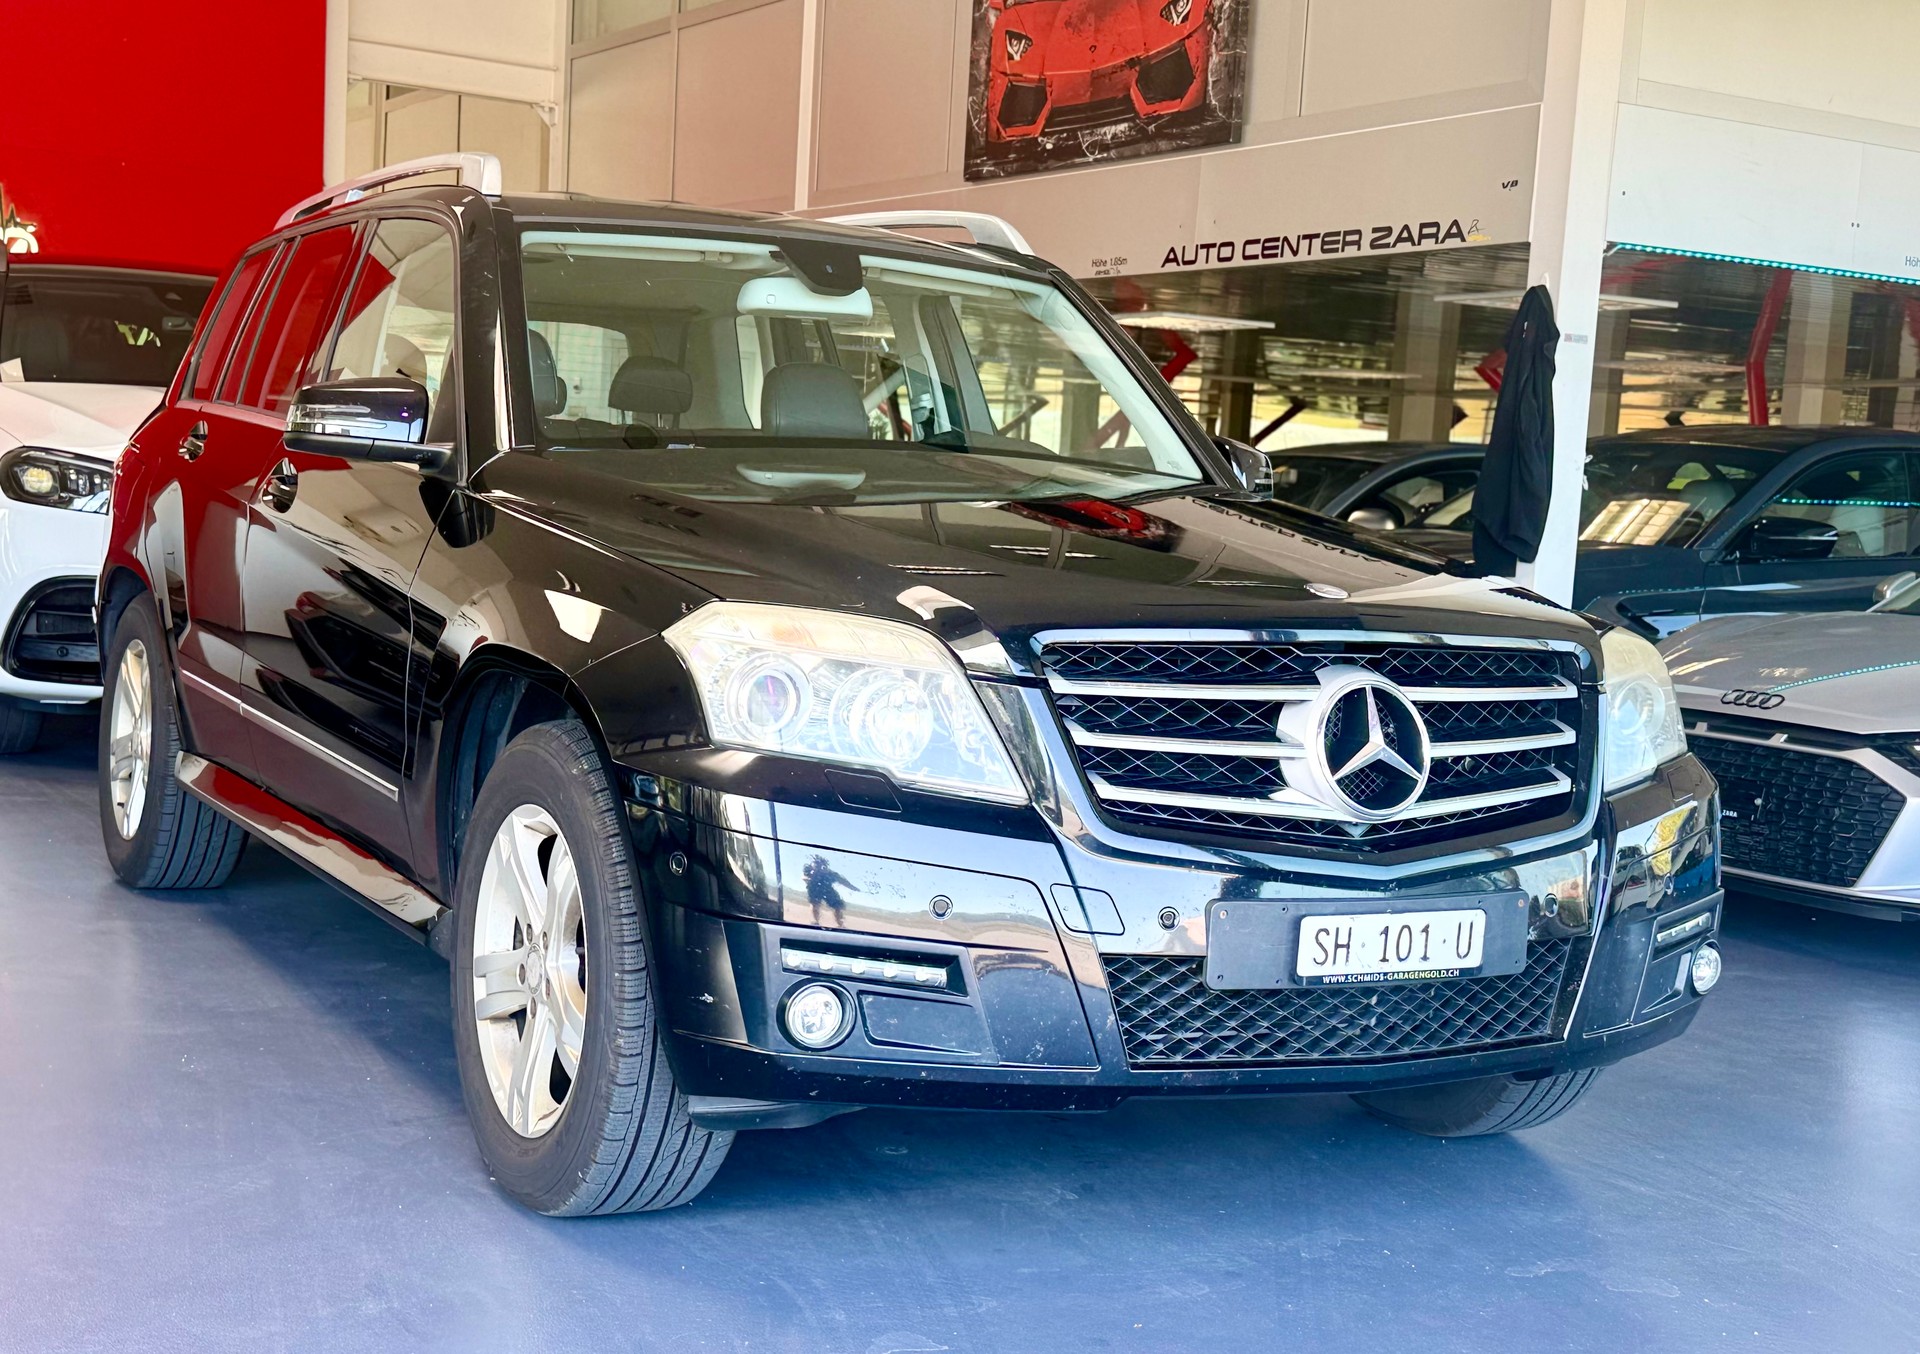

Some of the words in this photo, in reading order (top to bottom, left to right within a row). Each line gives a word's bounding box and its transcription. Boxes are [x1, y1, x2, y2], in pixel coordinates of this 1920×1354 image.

[1161, 241, 1235, 268] AUTO
[1241, 228, 1362, 261] CENTER
[1370, 218, 1467, 249] ZARA
[1313, 926, 1353, 966] SH
[1378, 923, 1431, 963] 101
[1456, 921, 1474, 960] U
